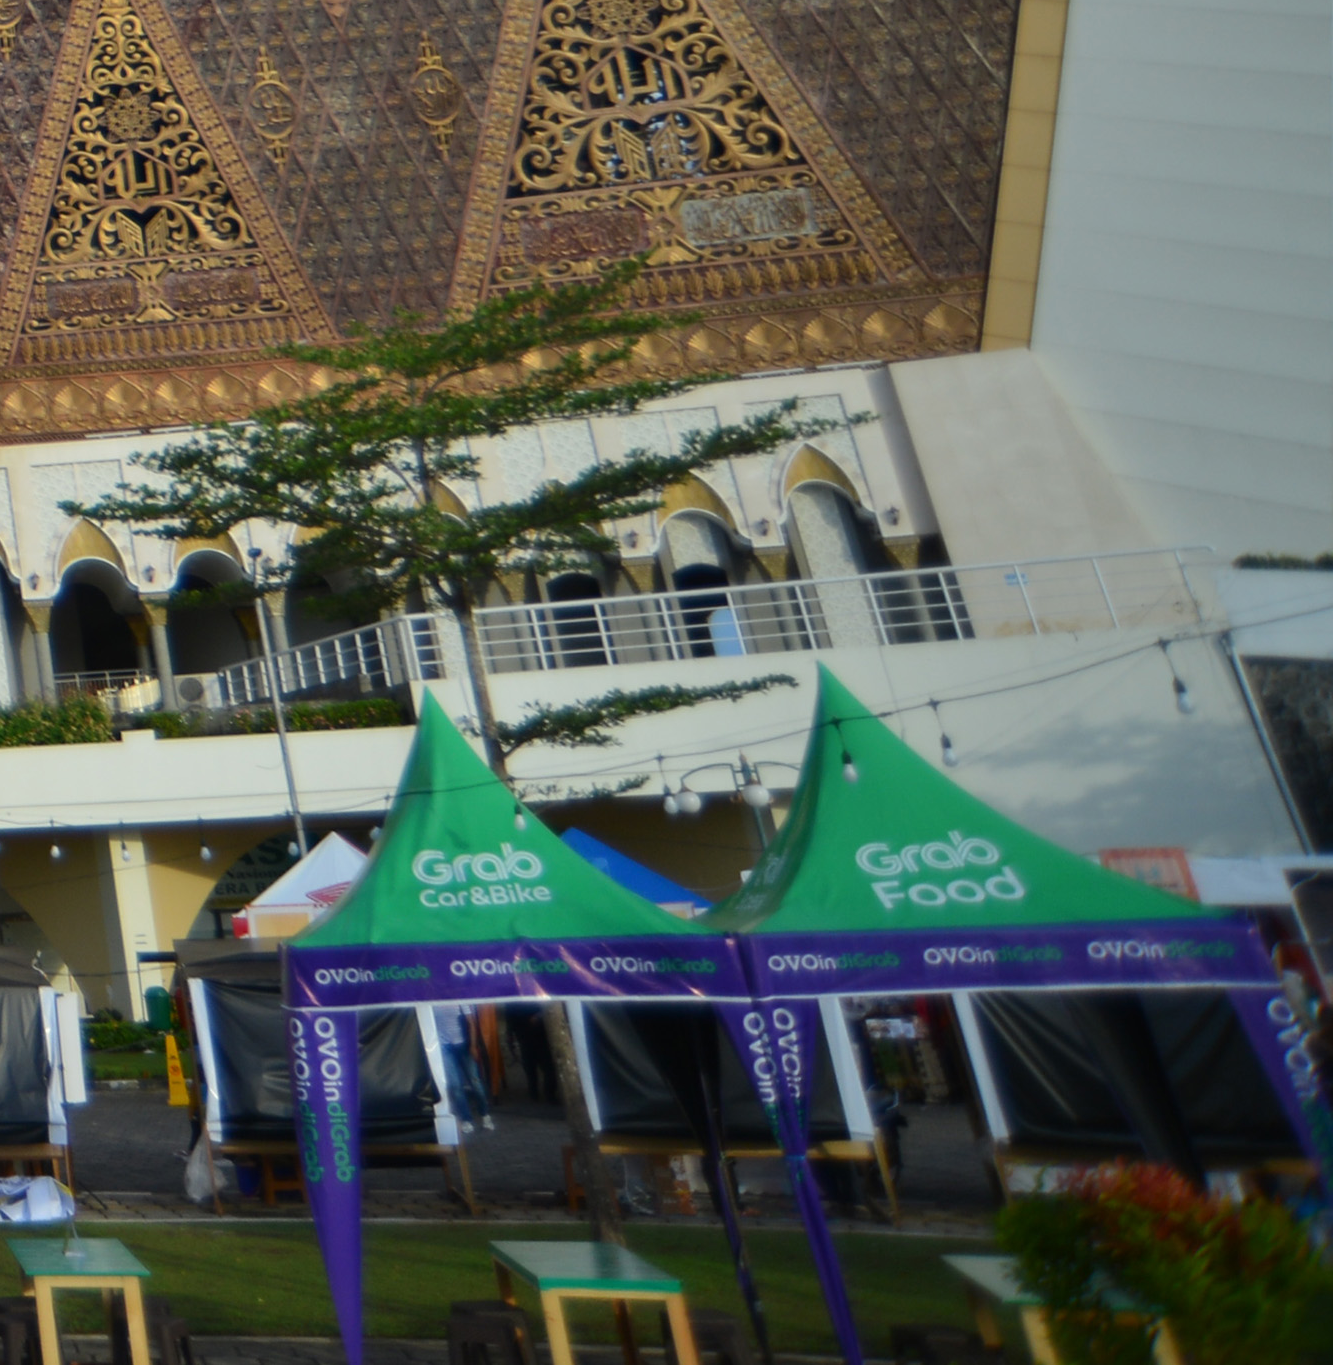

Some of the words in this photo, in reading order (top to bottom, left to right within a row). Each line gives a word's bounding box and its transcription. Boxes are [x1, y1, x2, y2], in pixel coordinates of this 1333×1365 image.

[412, 842, 543, 884] Grab
[856, 830, 1000, 877] Grab
[419, 883, 552, 908] Car&Bike
[871, 866, 1025, 909] Food
